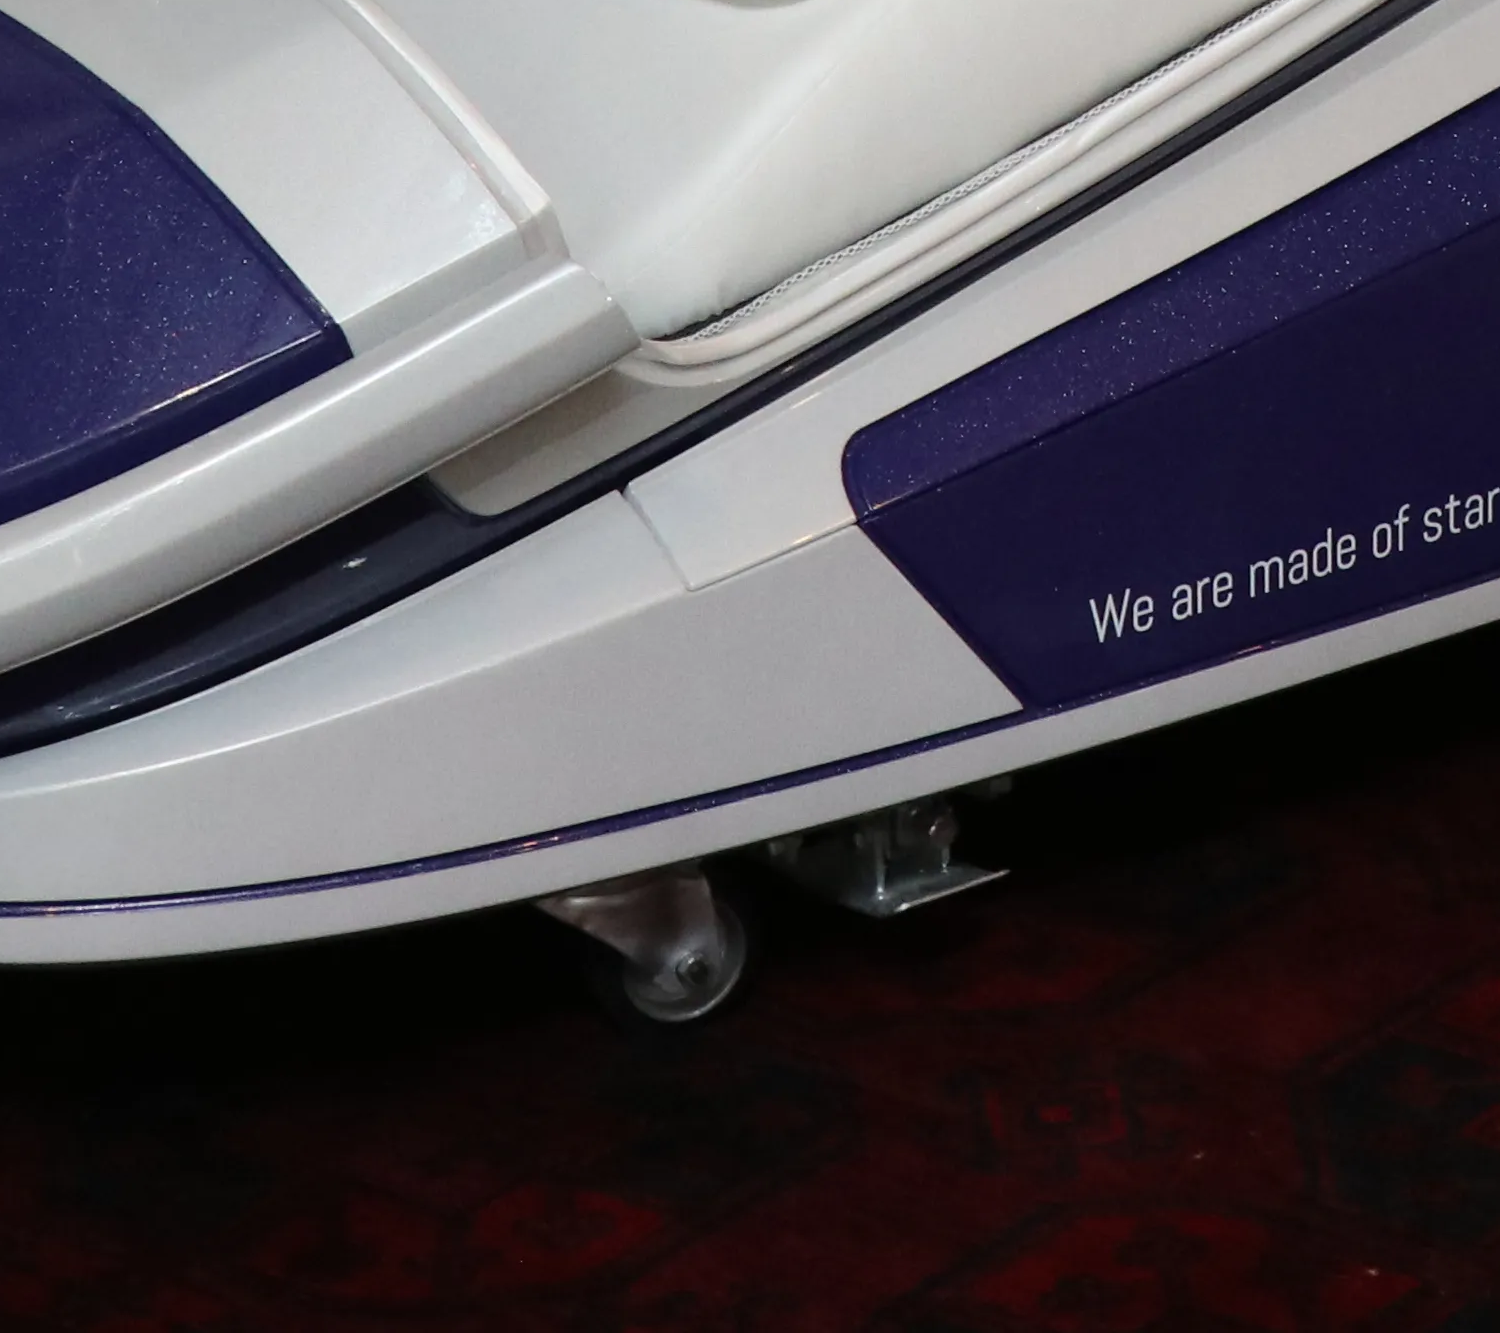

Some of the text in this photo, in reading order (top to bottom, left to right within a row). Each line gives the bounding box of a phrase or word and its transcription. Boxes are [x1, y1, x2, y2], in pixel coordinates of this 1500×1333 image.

[1088, 587, 1154, 644] We
[1171, 571, 1234, 621] are
[1249, 526, 1357, 598] made
[1372, 503, 1411, 559] of
[1422, 486, 1500, 543] star
